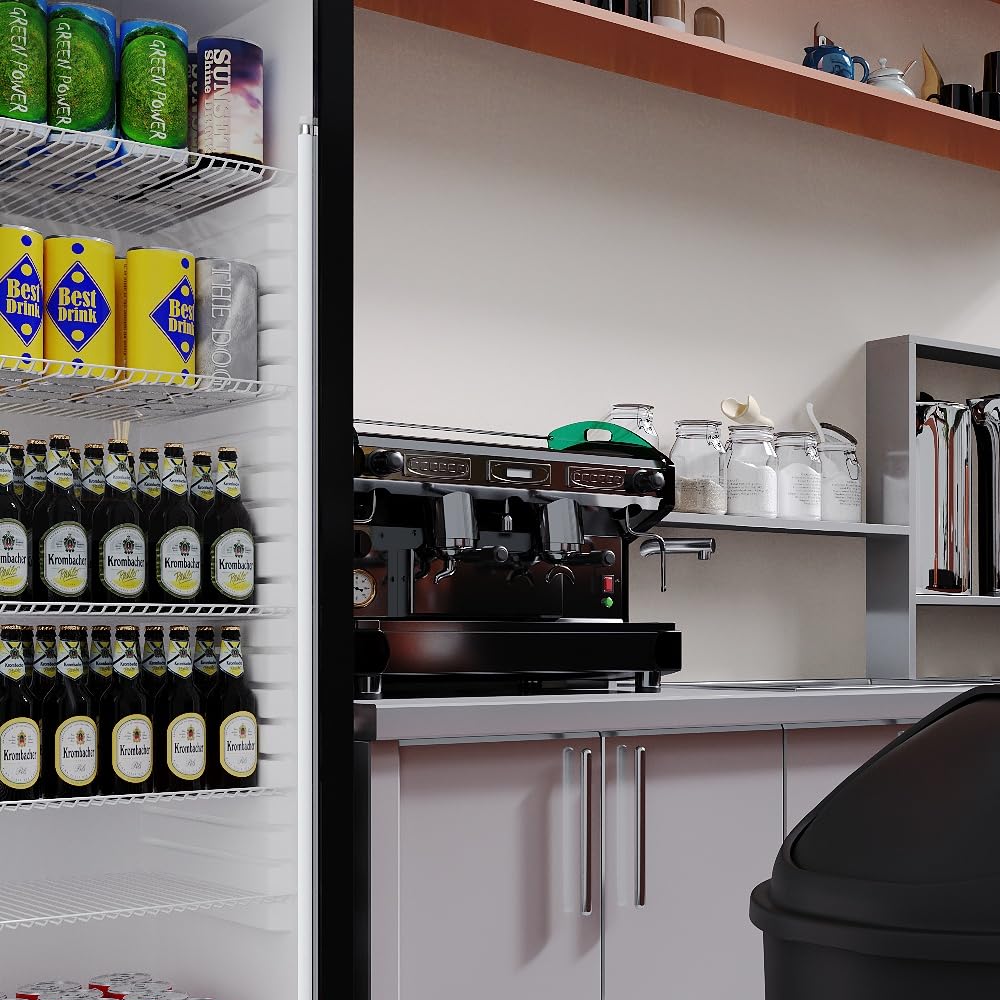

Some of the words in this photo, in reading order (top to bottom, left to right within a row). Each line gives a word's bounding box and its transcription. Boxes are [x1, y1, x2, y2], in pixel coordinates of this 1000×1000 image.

[9, 7, 28, 57] GREEN
[56, 22, 72, 70] GREEN
[148, 39, 167, 87] GREEN
[204, 49, 214, 94] Shine
[9, 60, 28, 113] POWER
[56, 75, 72, 126] POWER
[148, 89, 167, 140] POWER
[6, 278, 40, 302] Best
[6, 298, 40, 318] Drink
[58, 287, 97, 308] Best
[212, 262, 231, 319] THE
[57, 306, 97, 324] Drink
[168, 318, 195, 336] Drin
[48, 553, 86, 566] Krombacher
